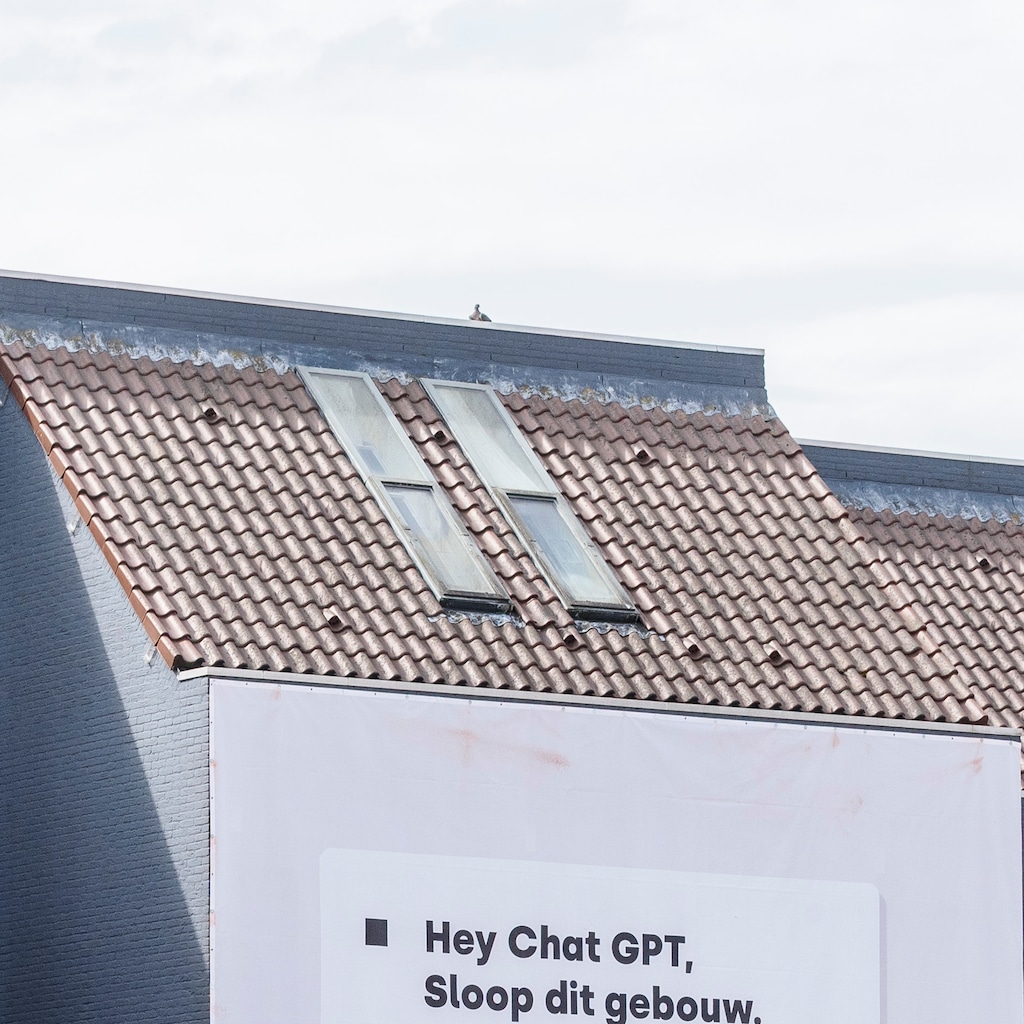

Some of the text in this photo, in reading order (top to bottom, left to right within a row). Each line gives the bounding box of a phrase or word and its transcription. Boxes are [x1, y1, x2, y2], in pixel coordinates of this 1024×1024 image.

[425, 920, 694, 974] Hey Chat GPT,
[424, 974, 534, 1022] Sloop
[545, 980, 595, 1016] dit
